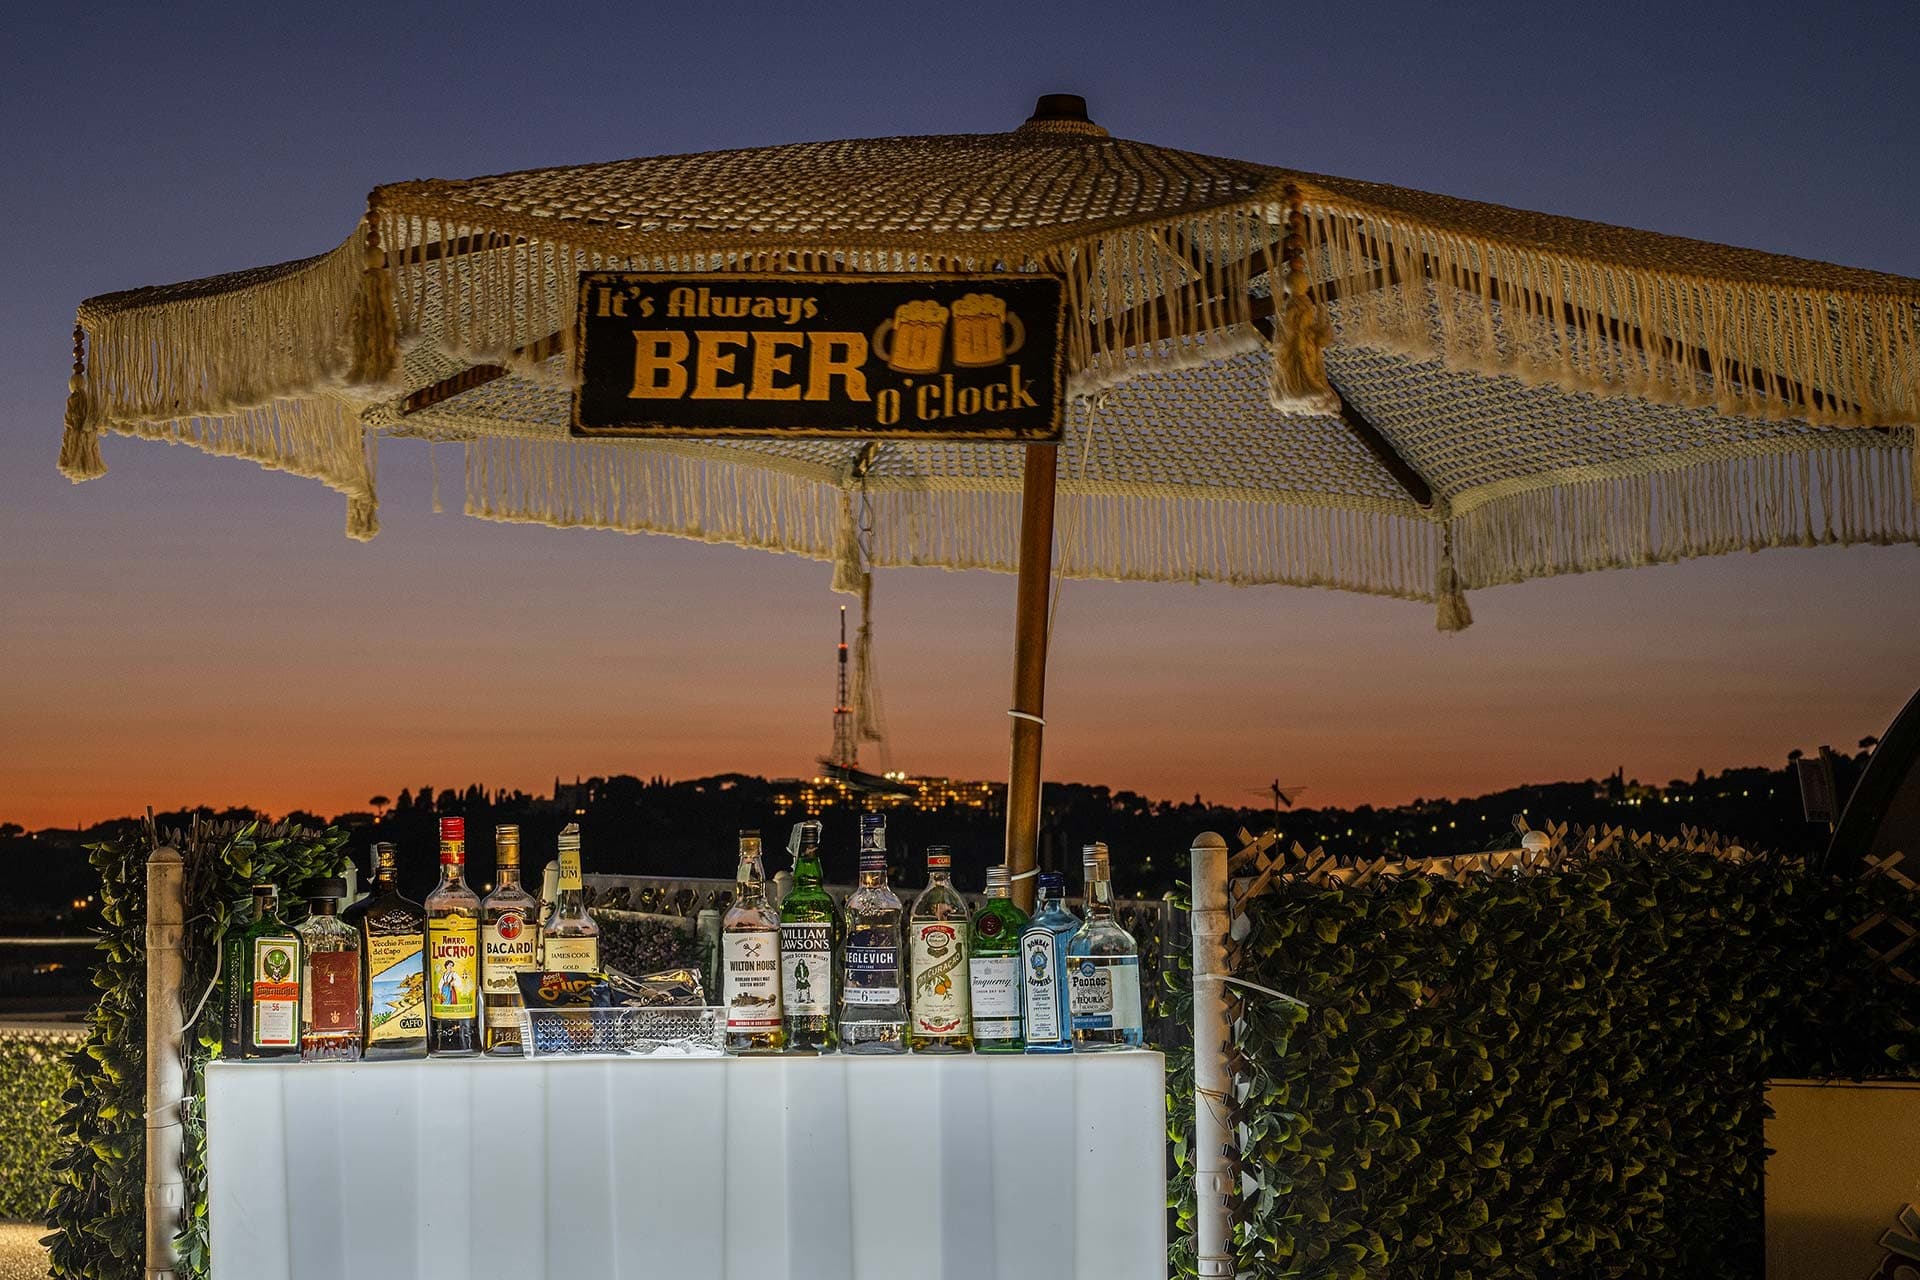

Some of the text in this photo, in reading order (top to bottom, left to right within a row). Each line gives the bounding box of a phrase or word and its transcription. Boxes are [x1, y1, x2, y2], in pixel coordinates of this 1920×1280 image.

[597, 286, 819, 325] It's Always
[627, 330, 872, 402] BEER
[876, 364, 1040, 425] o'clock
[442, 935, 466, 944] AMARO
[781, 928, 827, 939] WILLIAM
[431, 942, 475, 960] LUCANO
[1026, 938, 1050, 951] BOMBAY
[730, 960, 777, 972] WILTON HOUSE
[400, 1018, 423, 1029] CAFFO
